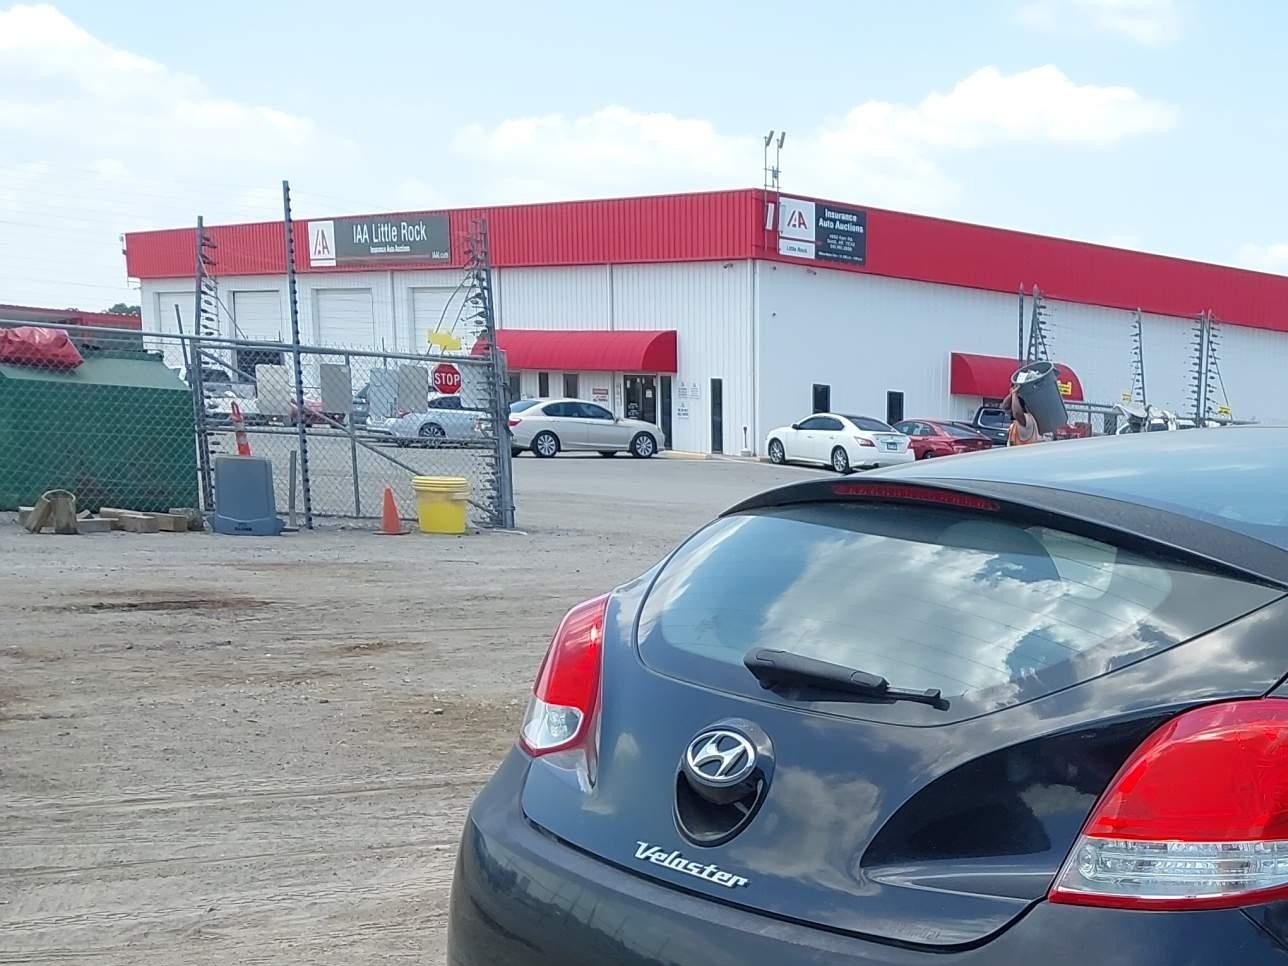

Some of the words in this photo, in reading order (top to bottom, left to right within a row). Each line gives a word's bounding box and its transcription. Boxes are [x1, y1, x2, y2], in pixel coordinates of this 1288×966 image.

[824, 208, 857, 222] Insurance
[353, 224, 370, 243] IAA
[372, 222, 398, 243] Little
[401, 220, 427, 241] Rock
[818, 218, 834, 229] Auto
[834, 220, 864, 233] Auctions
[434, 373, 460, 386] STOP
[635, 840, 750, 887] Veloster
